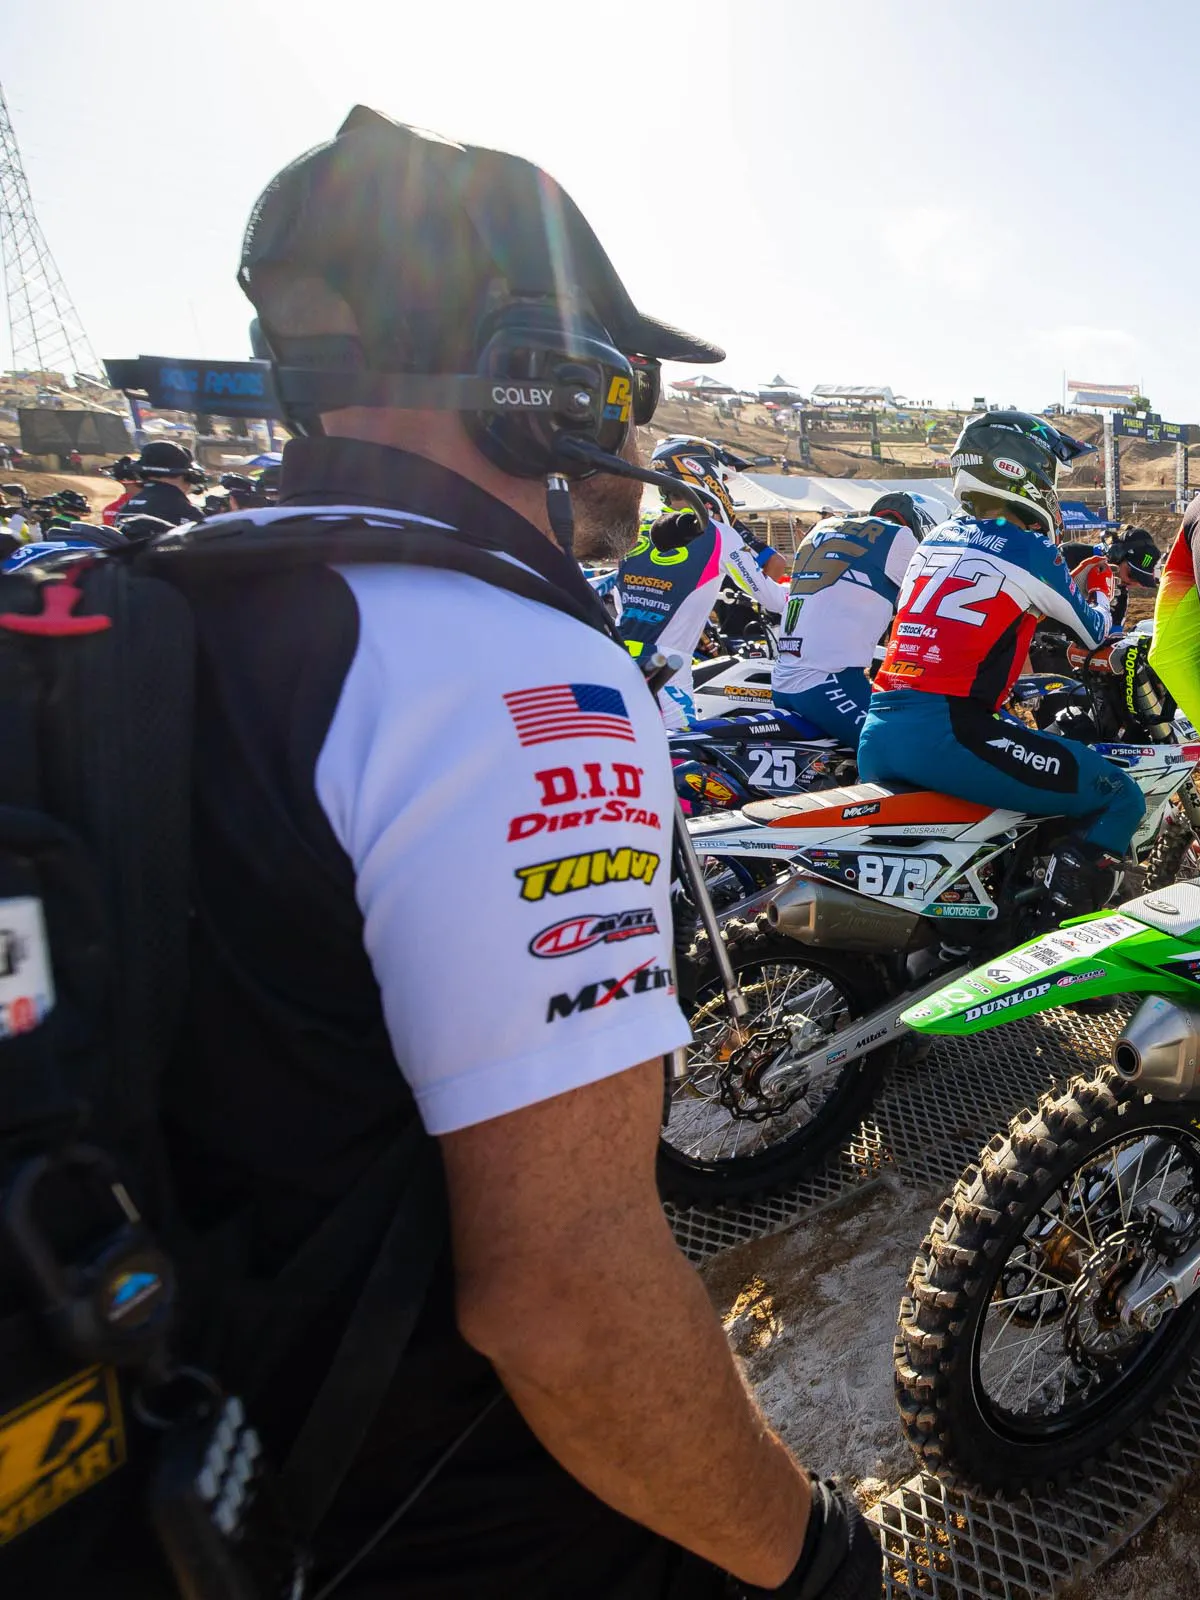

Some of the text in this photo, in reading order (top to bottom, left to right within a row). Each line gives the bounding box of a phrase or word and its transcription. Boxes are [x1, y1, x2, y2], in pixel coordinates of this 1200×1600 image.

[492, 387, 553, 405] COLBY
[1122, 418, 1144, 429] FINISH
[1163, 424, 1181, 434] FINISH
[685, 460, 702, 473] BELL
[998, 461, 1021, 476] BELL
[624, 574, 673, 591] ROCKSTAR
[735, 560, 758, 593] Husqvarna
[923, 627, 937, 638] 41
[889, 660, 924, 678] KTM
[724, 685, 773, 698] ROCKSTA
[749, 723, 781, 735] YAMAHA
[1004, 739, 1060, 775] raven
[748, 750, 796, 788] 25
[535, 763, 643, 807] D.I.D
[857, 855, 928, 902] 872
[943, 907, 980, 917] MOTOREX
[965, 982, 1050, 1022] DUNLOP
[853, 1027, 888, 1050] Mitas
